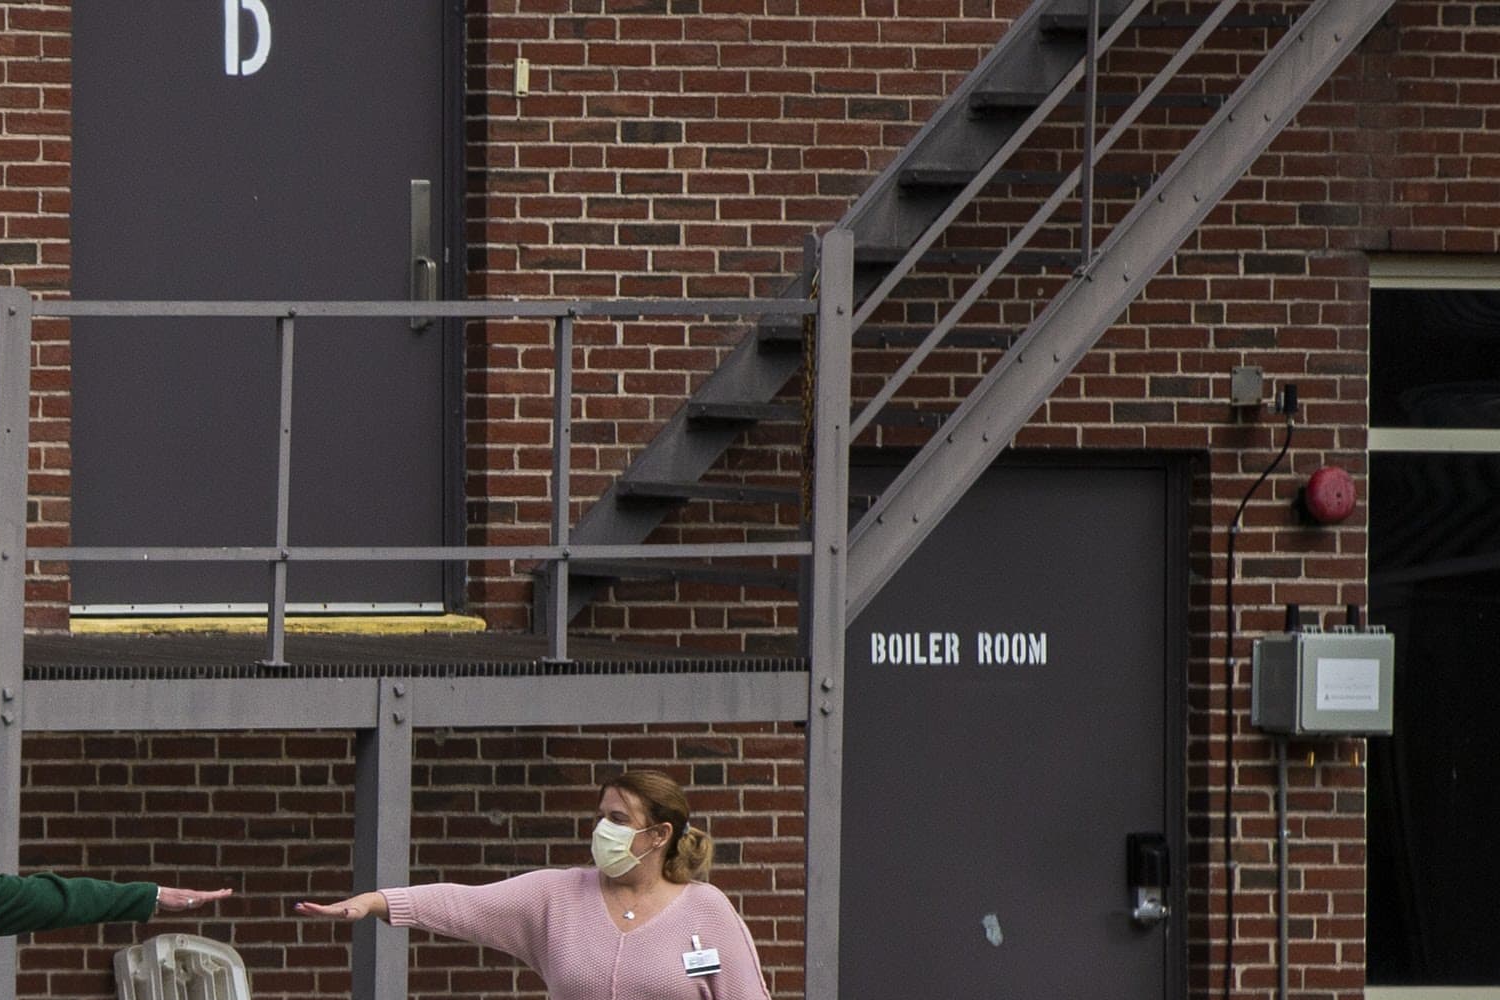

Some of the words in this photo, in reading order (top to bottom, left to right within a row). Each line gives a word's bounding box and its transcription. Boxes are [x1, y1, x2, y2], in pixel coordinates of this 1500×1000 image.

[224, 0, 272, 76] D
[871, 632, 960, 665] BOILER
[977, 632, 1047, 665] ROOM
